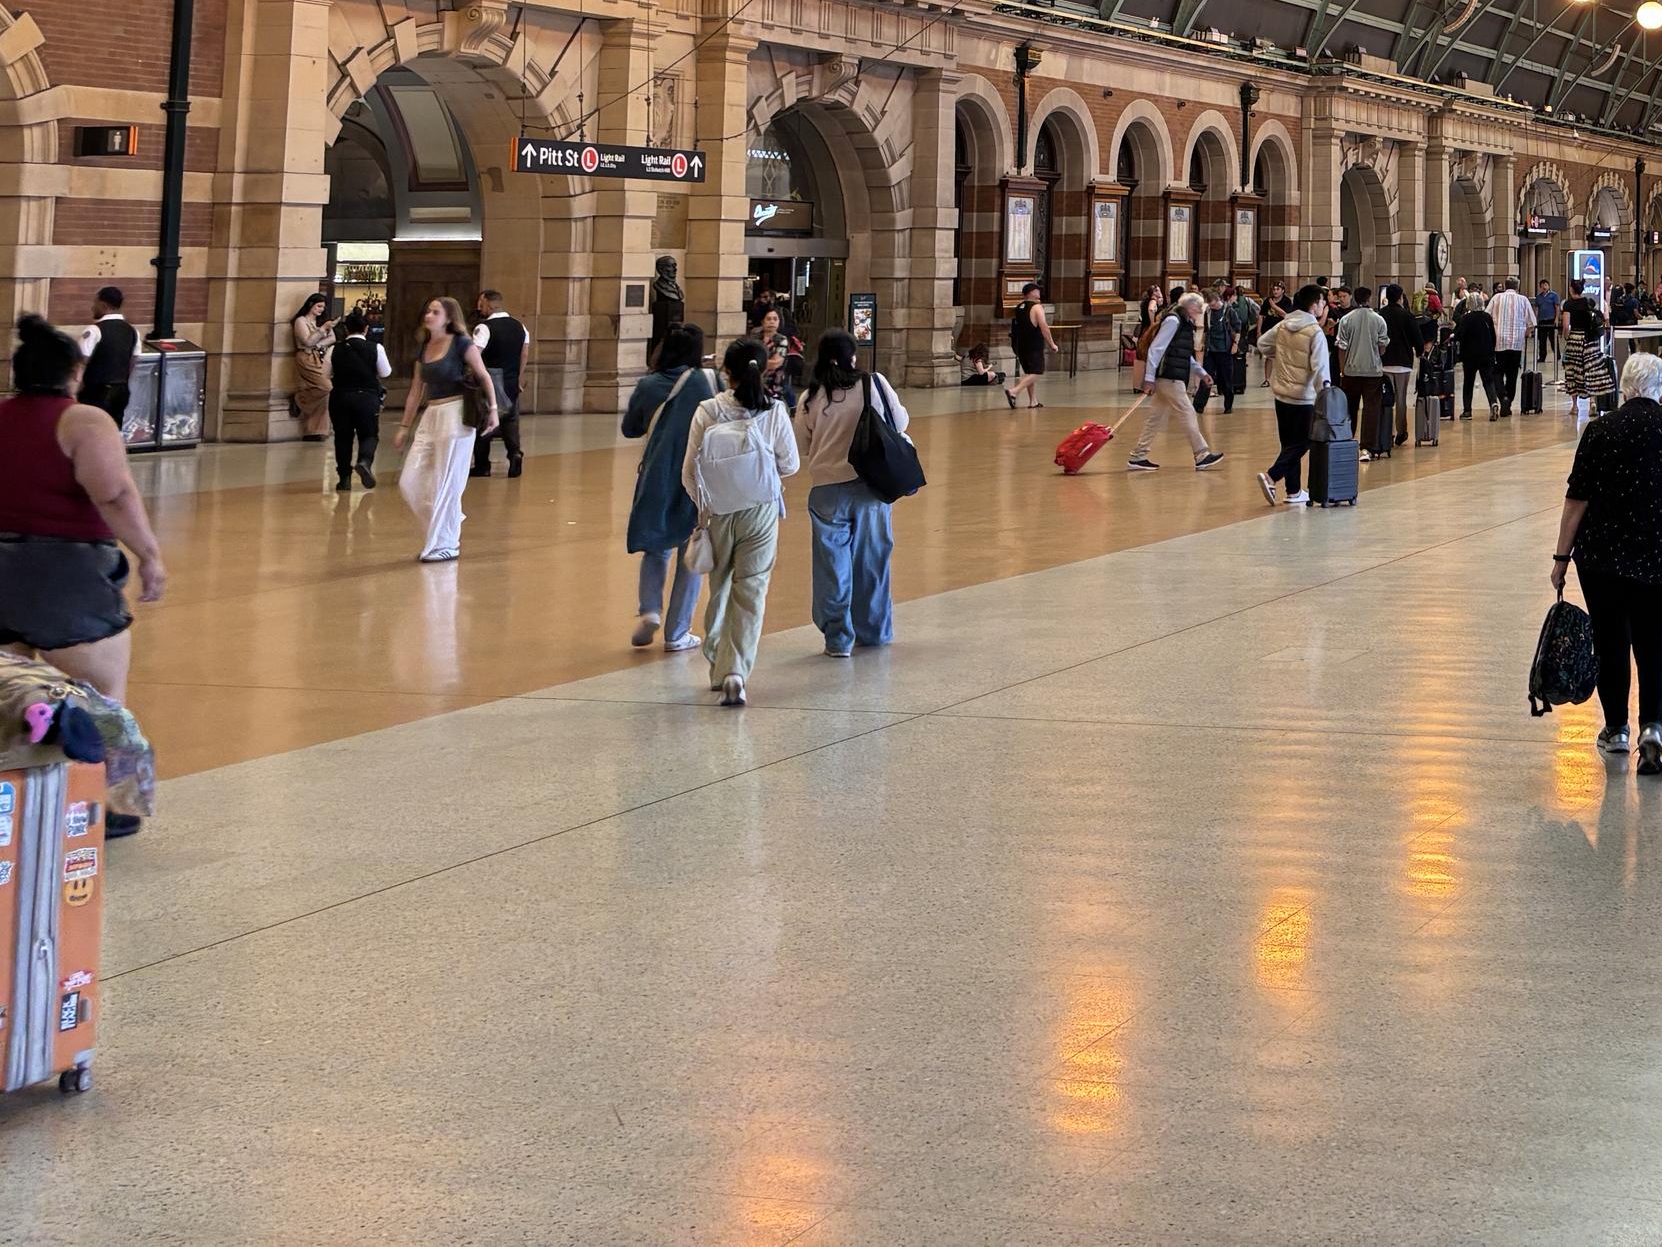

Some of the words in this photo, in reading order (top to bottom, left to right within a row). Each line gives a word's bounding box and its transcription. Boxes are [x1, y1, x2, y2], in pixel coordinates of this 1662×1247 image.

[539, 147, 563, 166] Pitt
[565, 149, 579, 167] St
[586, 154, 594, 166] L
[600, 154, 614, 163] Light
[614, 154, 625, 162] Rail
[641, 155, 657, 166] Light
[658, 156, 671, 166] Rail
[676, 159, 683, 171] L
